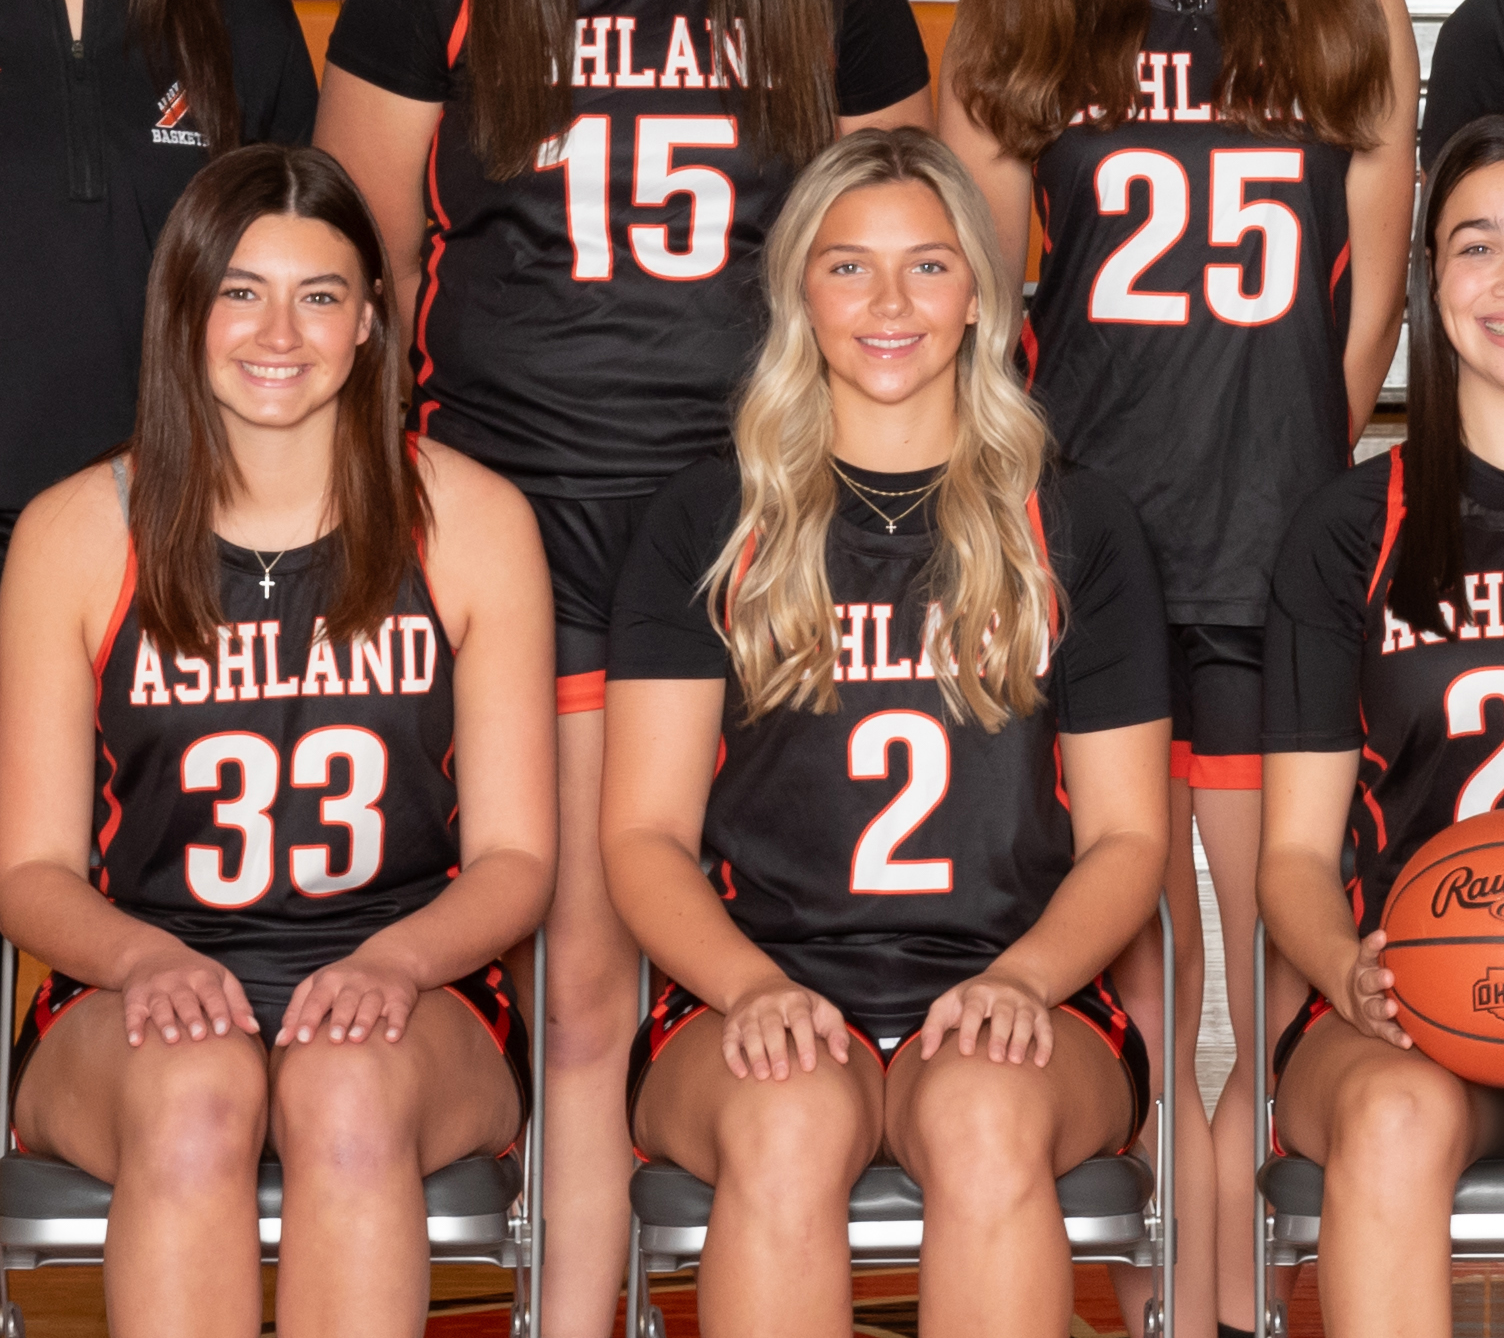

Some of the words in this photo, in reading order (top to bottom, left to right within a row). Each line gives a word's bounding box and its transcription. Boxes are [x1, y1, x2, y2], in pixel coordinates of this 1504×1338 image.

[533, 113, 738, 282] 15
[1087, 147, 1304, 327] 25
[179, 723, 389, 910] 33
[847, 708, 953, 895] 2
